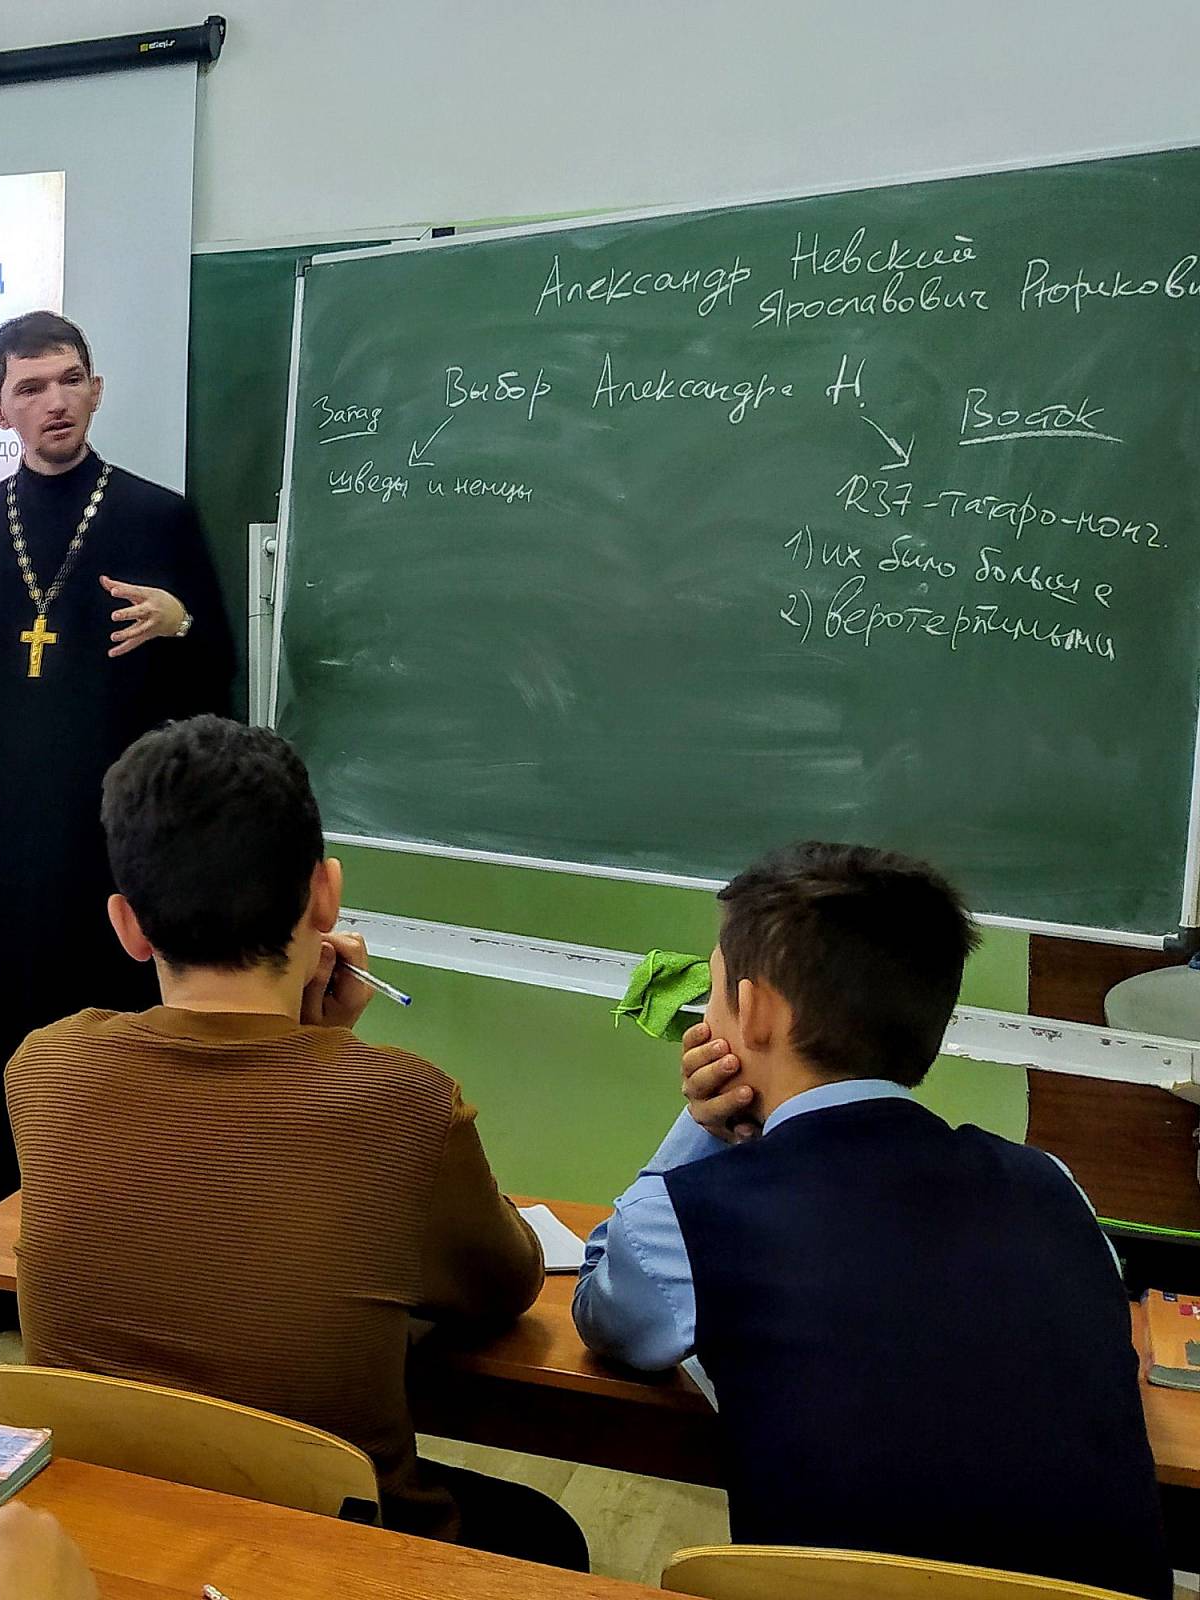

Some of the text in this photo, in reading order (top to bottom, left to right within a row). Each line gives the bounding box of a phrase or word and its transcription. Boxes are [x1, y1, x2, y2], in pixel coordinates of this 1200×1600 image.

[535, 227, 977, 316] Александр Невский
[751, 272, 990, 329] Ярославович
[312, 396, 383, 431] Запад
[446, 366, 552, 421] Выбор
[591, 352, 794, 425] Александра
[960, 388, 1105, 434] Восток
[329, 461, 533, 503] шведы и немцы
[822, 541, 862, 568] их
[878, 535, 957, 578] было
[975, 547, 1114, 608] больше
[779, 590, 814, 643] 2)
